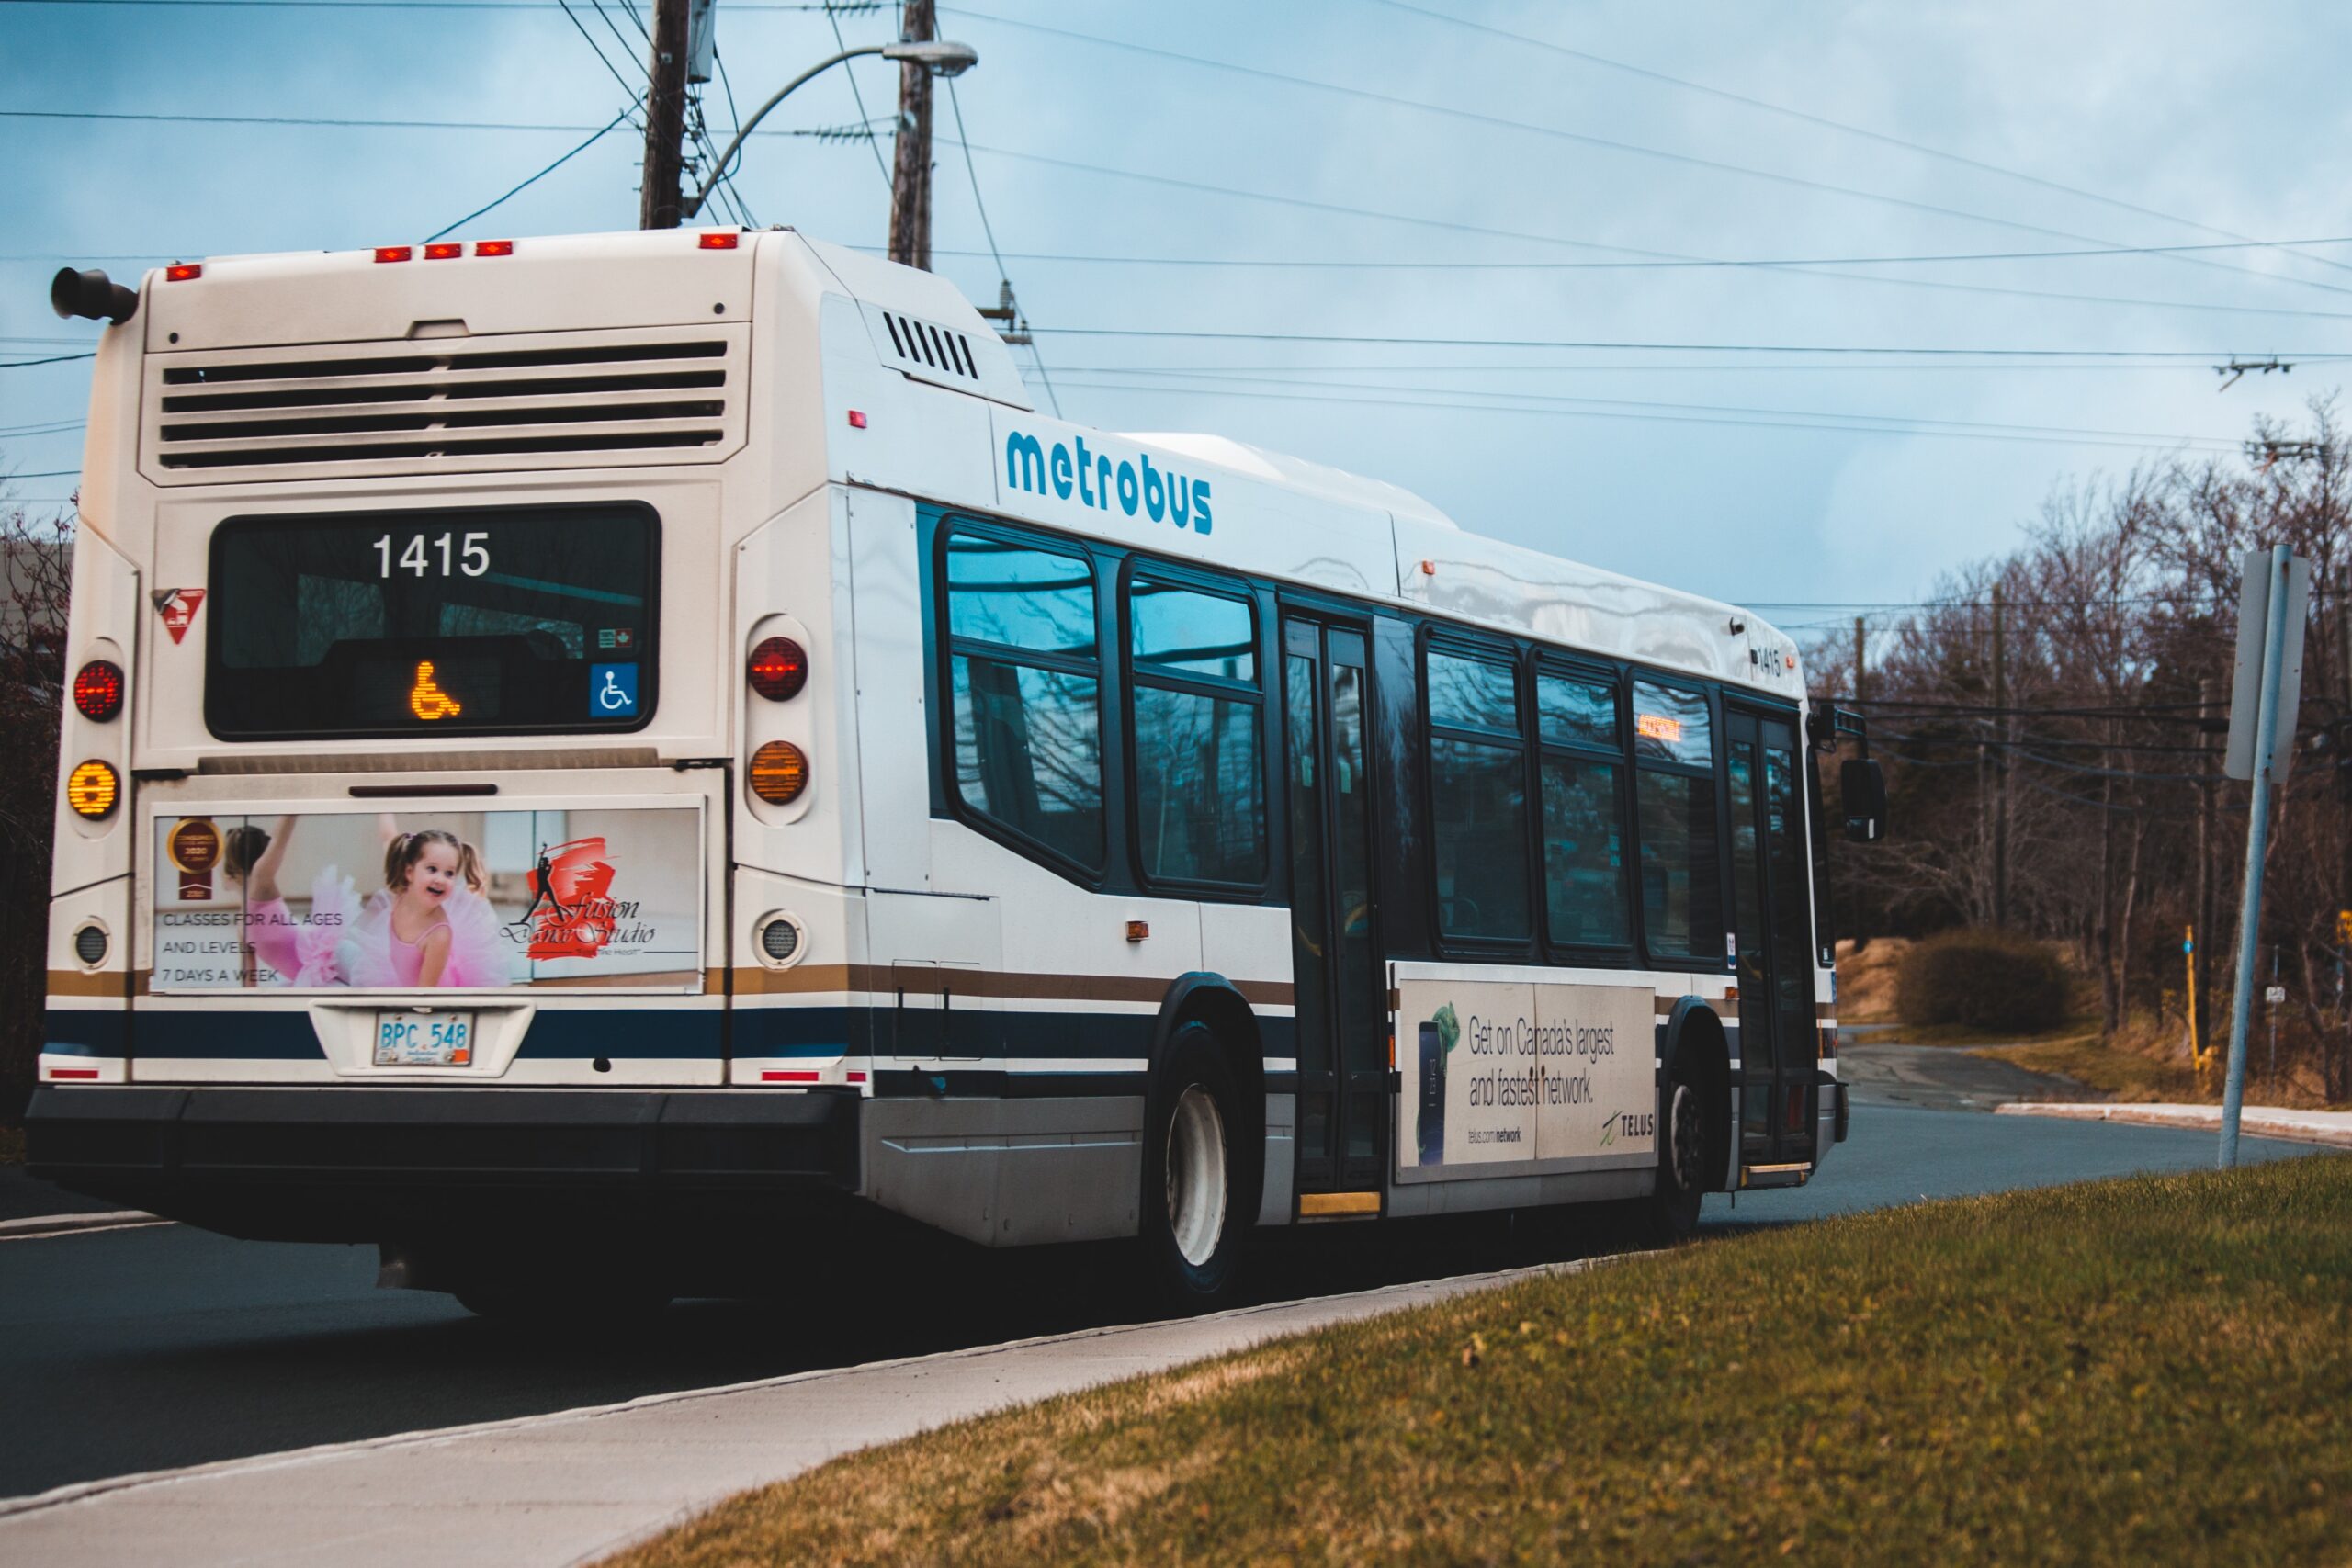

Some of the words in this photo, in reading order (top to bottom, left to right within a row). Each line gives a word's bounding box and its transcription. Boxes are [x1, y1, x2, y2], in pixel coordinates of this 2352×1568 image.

[1006, 430, 1213, 536] metrobus
[373, 532, 490, 578] 1415
[1758, 647, 1781, 678] 1415
[163, 913, 230, 927] CLASSES
[233, 913, 266, 926] FOR
[268, 913, 297, 926] ALL
[302, 912, 343, 926] AGES
[499, 922, 573, 944] Dance
[576, 921, 656, 945] Studio
[163, 942, 196, 953] AND
[200, 941, 257, 953] LEVELS
[163, 969, 171, 982] 7
[175, 969, 214, 982] DAYS
[218, 969, 229, 982] A
[234, 968, 279, 982] WEEK
[380, 1022, 419, 1049] BPC
[430, 1022, 467, 1049] 548
[1469, 1015, 1493, 1055] Get
[1496, 1026, 1513, 1055] on
[1516, 1017, 1573, 1055] Canada's
[1575, 1018, 1615, 1065] largest
[1470, 1067, 1495, 1106] and
[1498, 1067, 1540, 1106] fastest
[1543, 1066, 1594, 1105] network.
[1622, 1113, 1654, 1137] TELUS
